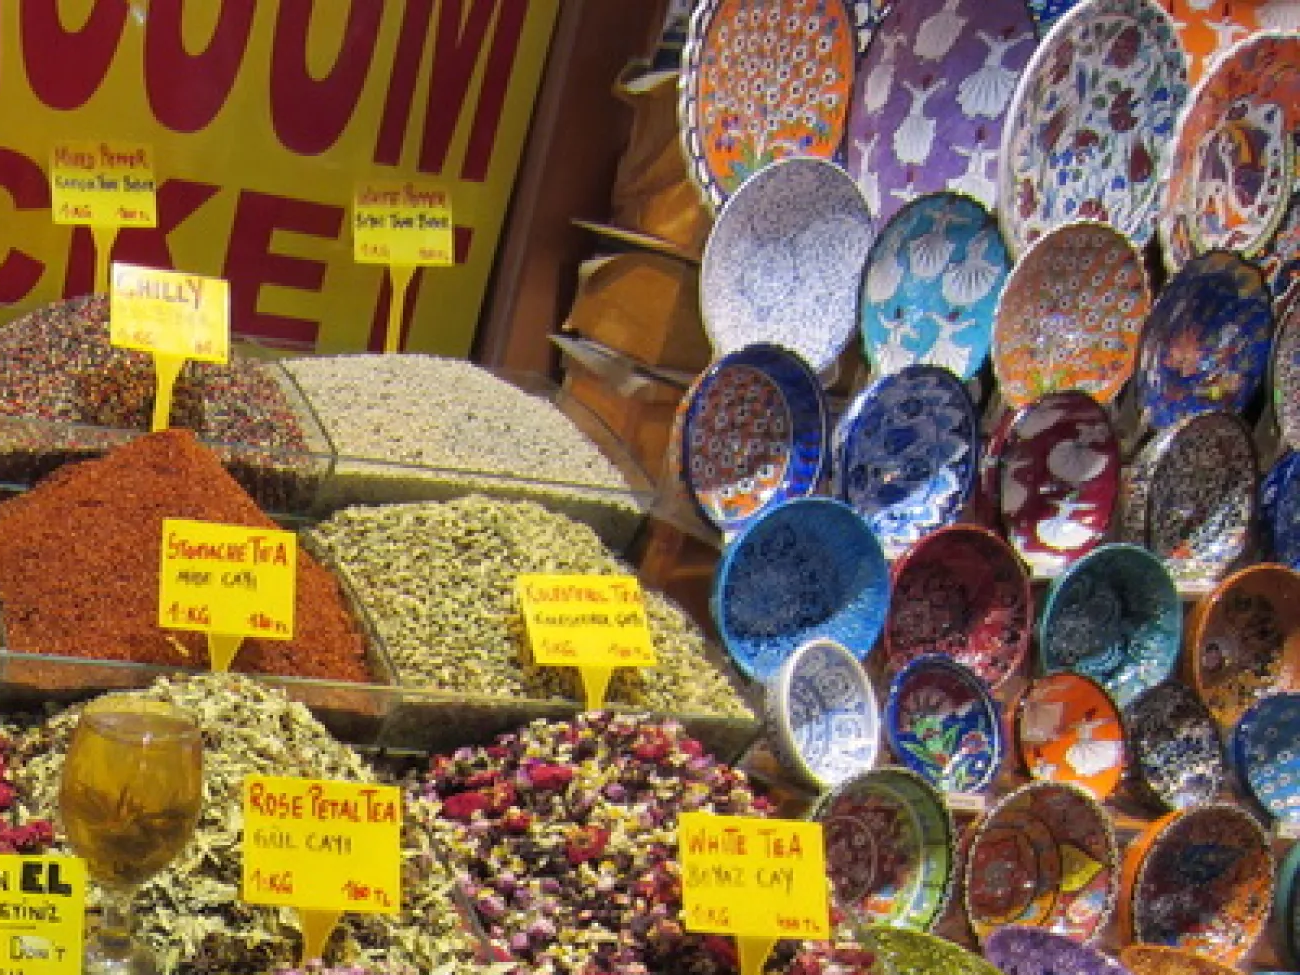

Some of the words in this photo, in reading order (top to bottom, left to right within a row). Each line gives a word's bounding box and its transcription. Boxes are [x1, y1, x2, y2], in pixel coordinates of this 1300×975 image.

[250, 783, 304, 819] ROSE
[308, 783, 361, 823] PETAL
[357, 790, 397, 823] TEA
[685, 826, 748, 856] WHITE
[757, 828, 804, 861] TEA
[20, 860, 73, 897] EL
